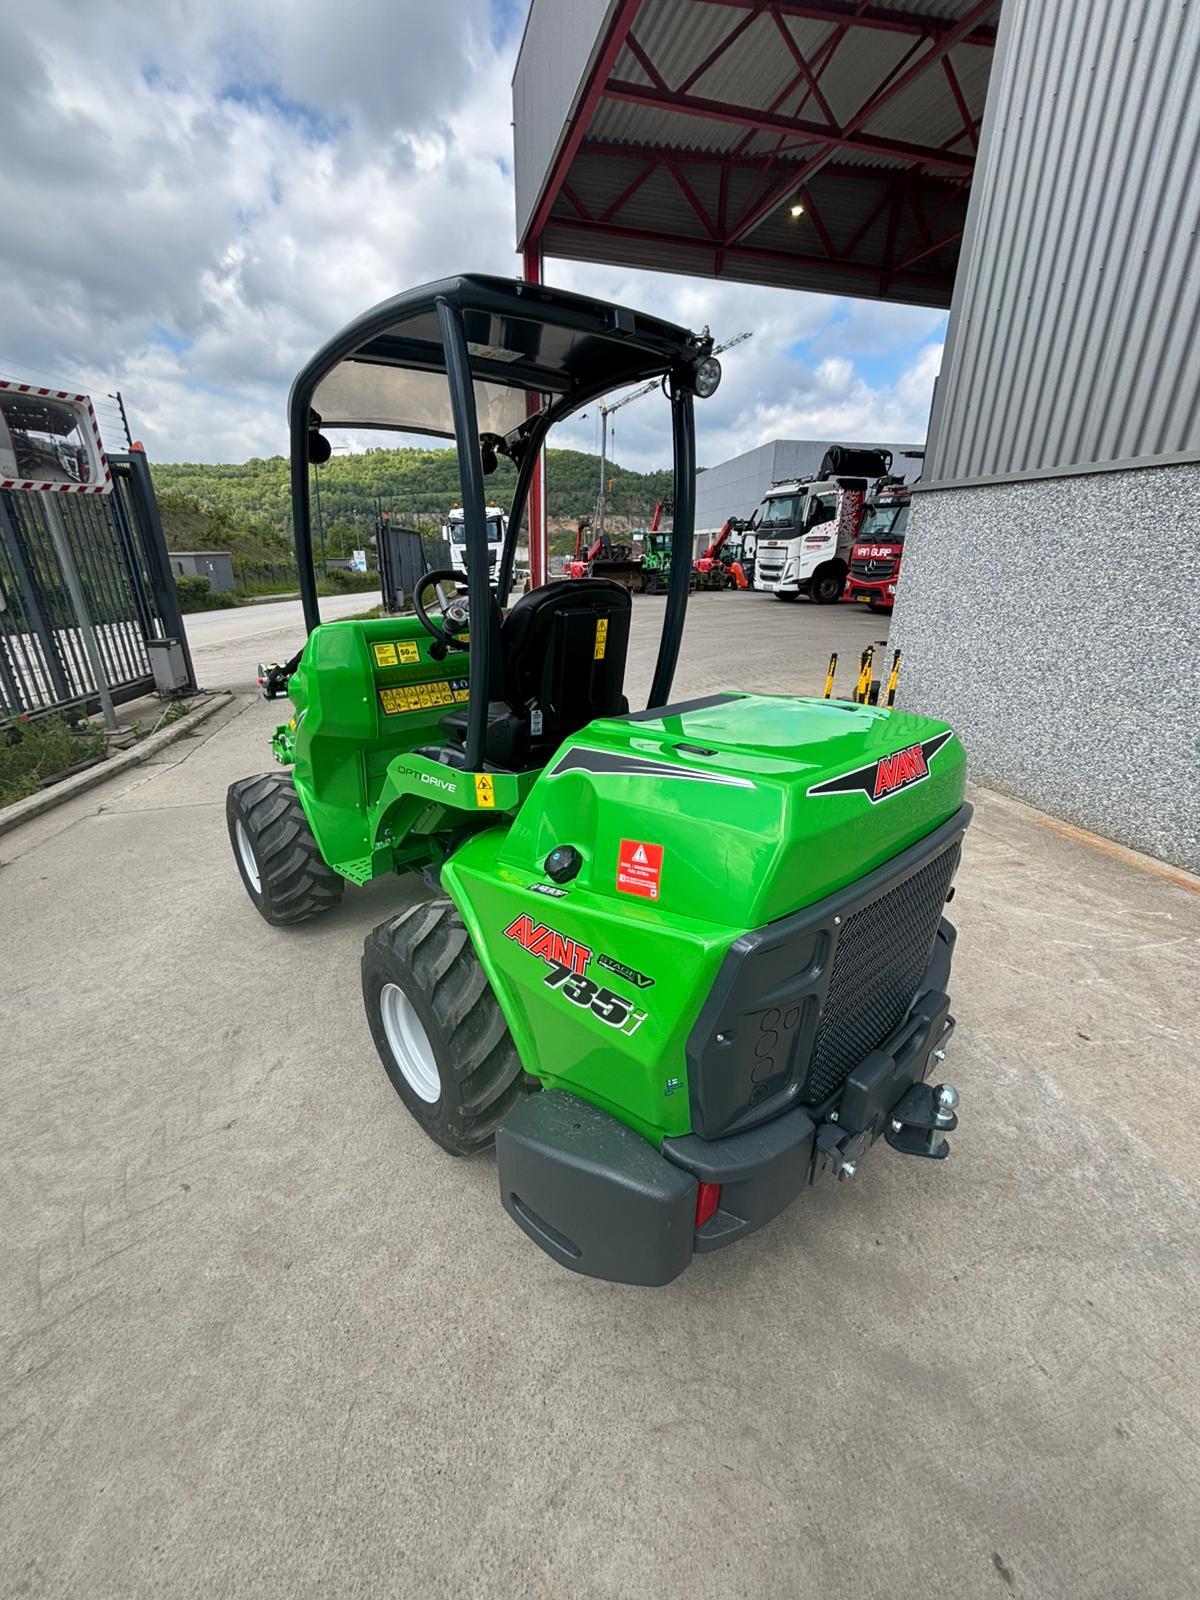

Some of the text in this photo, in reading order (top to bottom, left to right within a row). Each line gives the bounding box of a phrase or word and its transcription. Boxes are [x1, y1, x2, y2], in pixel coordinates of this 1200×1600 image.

[400, 648, 411, 656] 50
[397, 765, 457, 793] OPTIDRIVE
[873, 742, 929, 799] AVANT
[502, 912, 595, 977] AVANT
[543, 957, 648, 1036] 735i
